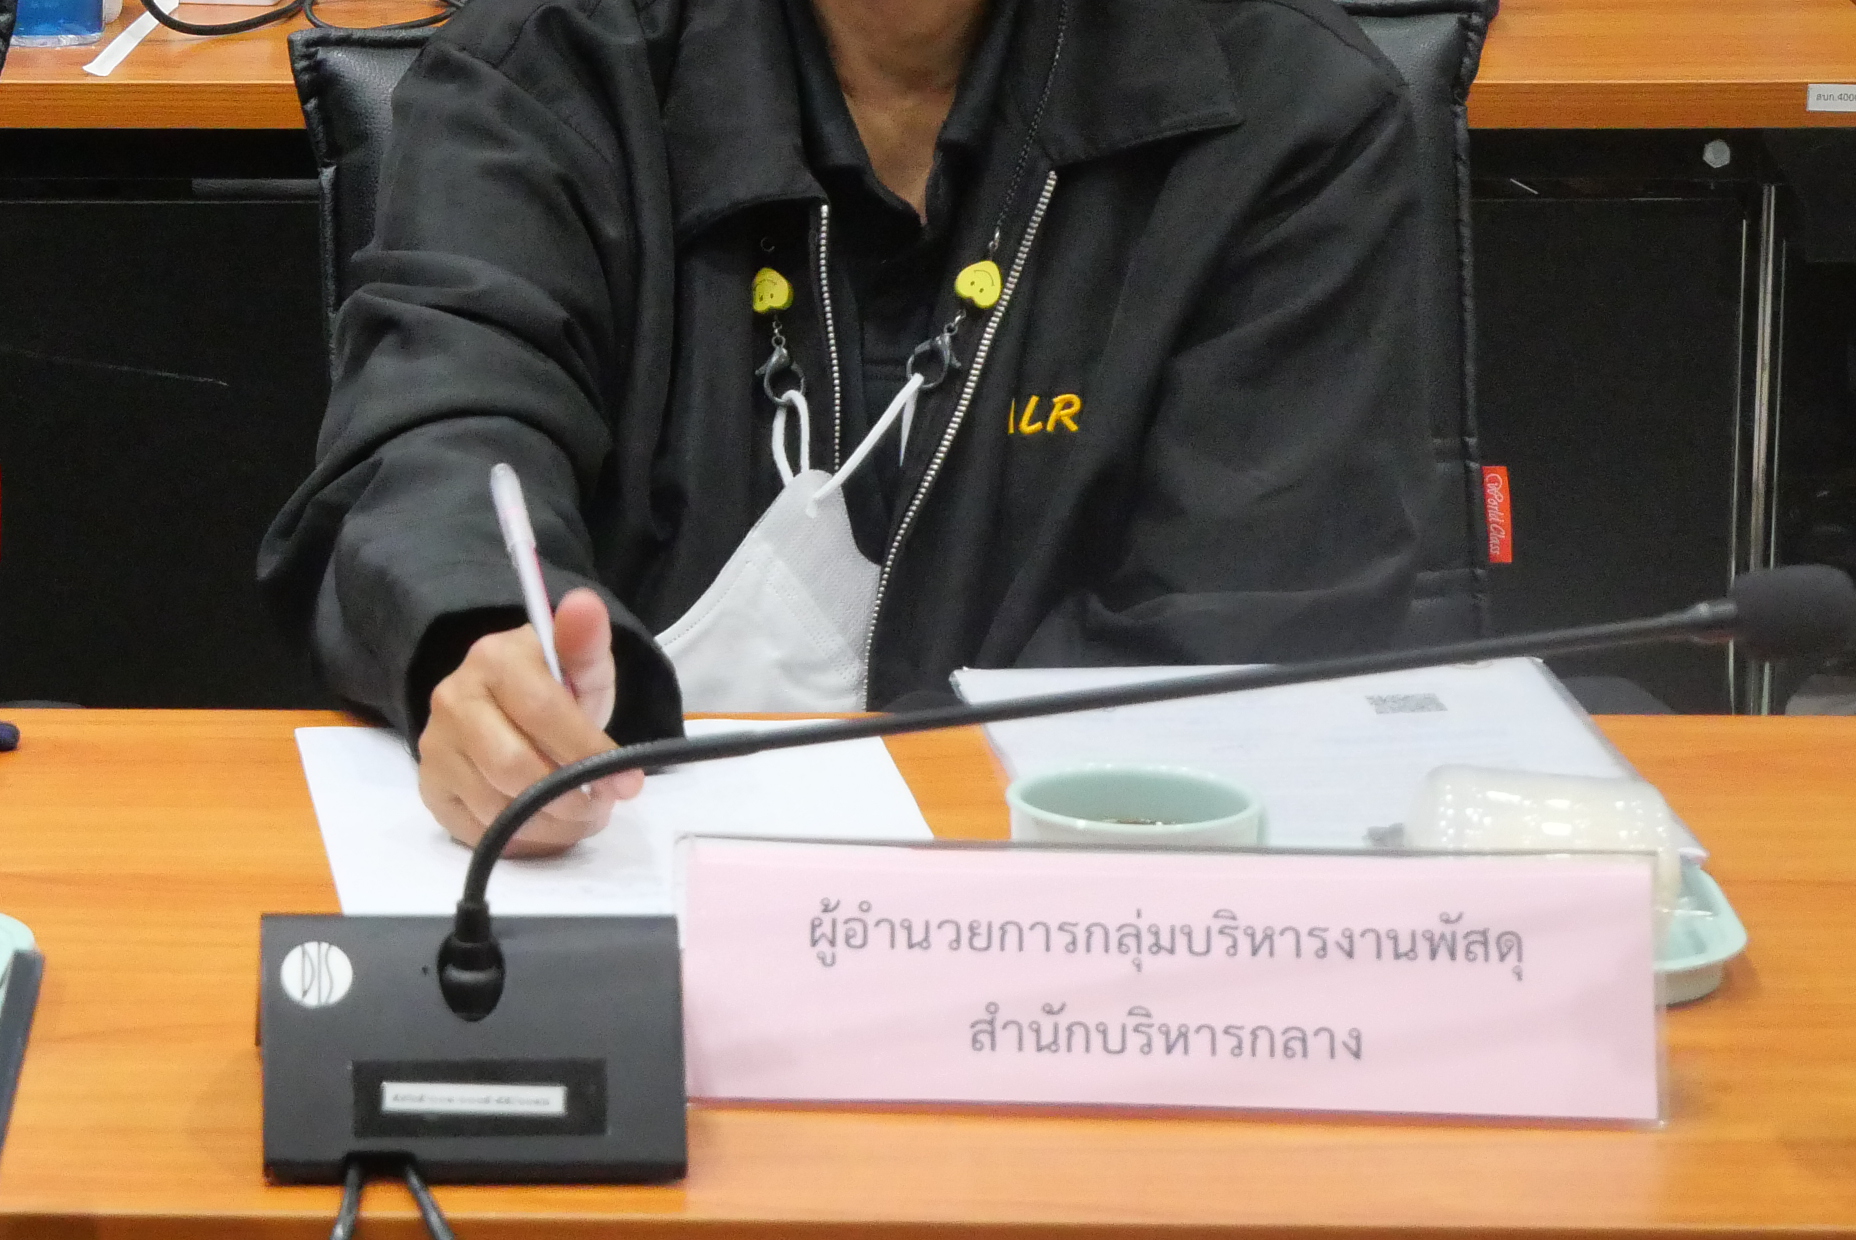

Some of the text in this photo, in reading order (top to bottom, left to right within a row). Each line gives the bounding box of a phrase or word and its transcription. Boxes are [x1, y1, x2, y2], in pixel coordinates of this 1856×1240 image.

[1485, 473, 1506, 555] World Class
[808, 897, 1524, 982] ผู้อำนวยการกลุ่มบริหารงานพัสดุ
[968, 1001, 1363, 1061] สำนักบริหารกลาง
